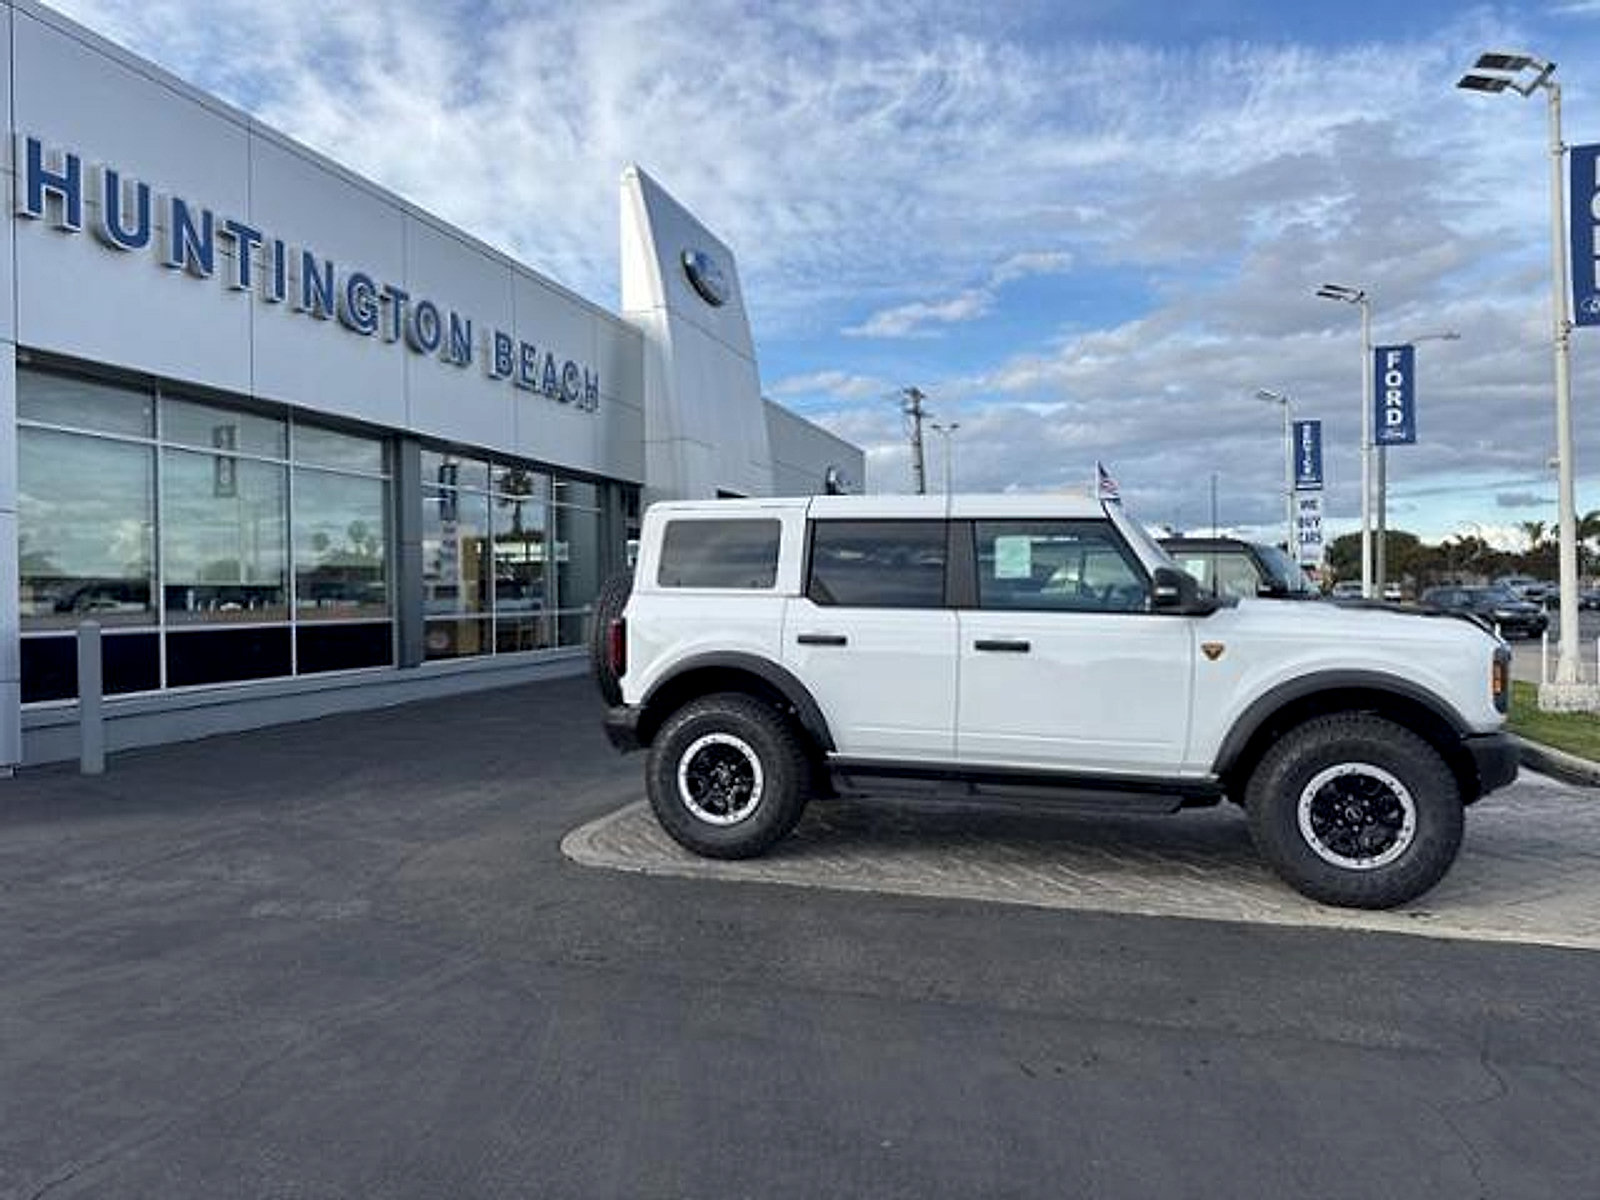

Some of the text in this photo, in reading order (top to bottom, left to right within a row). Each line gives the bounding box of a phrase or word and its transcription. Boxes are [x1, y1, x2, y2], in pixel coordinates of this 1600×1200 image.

[18, 135, 600, 412] HUNTINGTON BEACH
[1385, 351, 1403, 426] FORD
